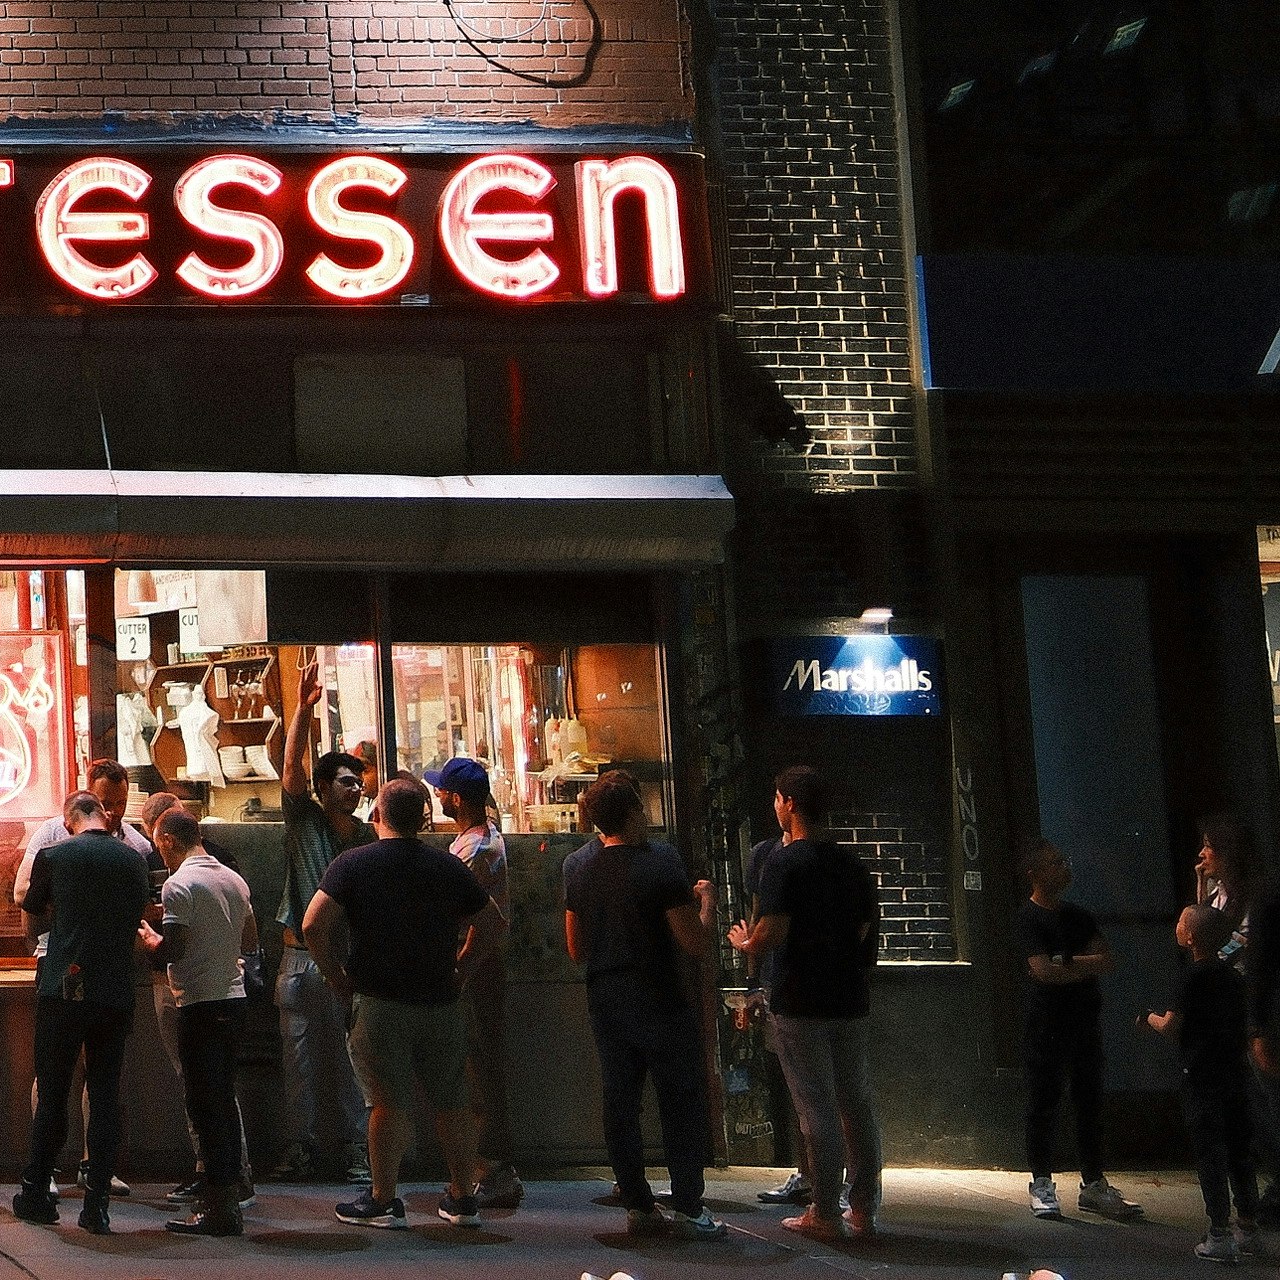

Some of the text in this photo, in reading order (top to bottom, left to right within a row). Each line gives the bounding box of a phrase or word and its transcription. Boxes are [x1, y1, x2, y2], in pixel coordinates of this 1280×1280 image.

[118, 623, 147, 635] CUTTER
[129, 637, 137, 654] 2
[783, 659, 933, 692] Marshalls
